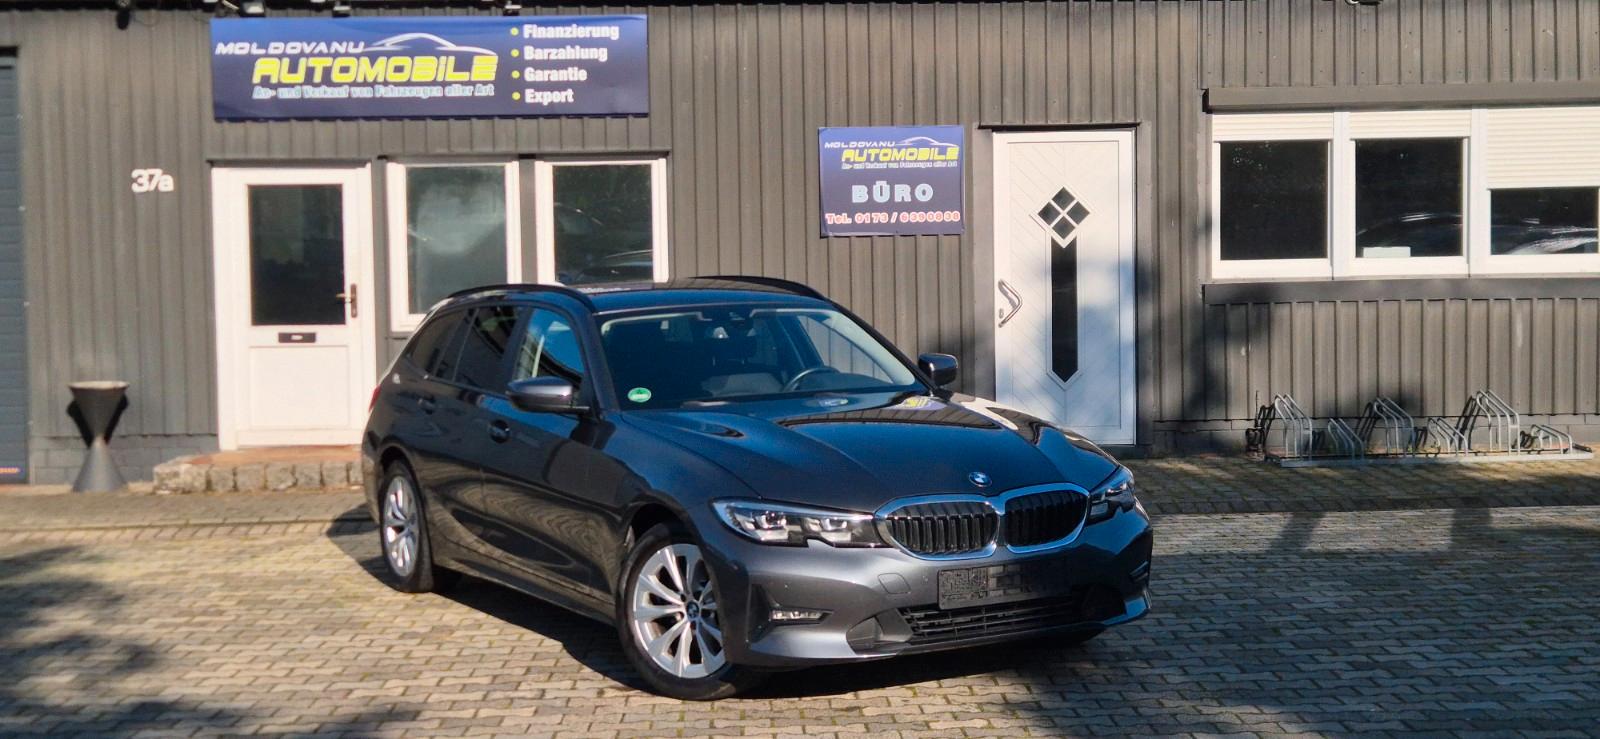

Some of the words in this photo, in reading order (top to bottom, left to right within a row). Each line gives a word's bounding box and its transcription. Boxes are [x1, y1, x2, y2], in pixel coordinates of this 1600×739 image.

[523, 24, 620, 41] Finanzierung
[215, 41, 364, 55] MOLDOVANU
[523, 45, 608, 62] Barzahlung
[252, 55, 498, 84] AUTOMOBILE
[524, 66, 588, 82] Garantie
[525, 88, 575, 105] Export
[841, 147, 960, 162] AUTOMOBILE
[131, 168, 174, 193] 37a
[851, 180, 934, 204] BÜRO
[825, 213, 852, 225] Tel.
